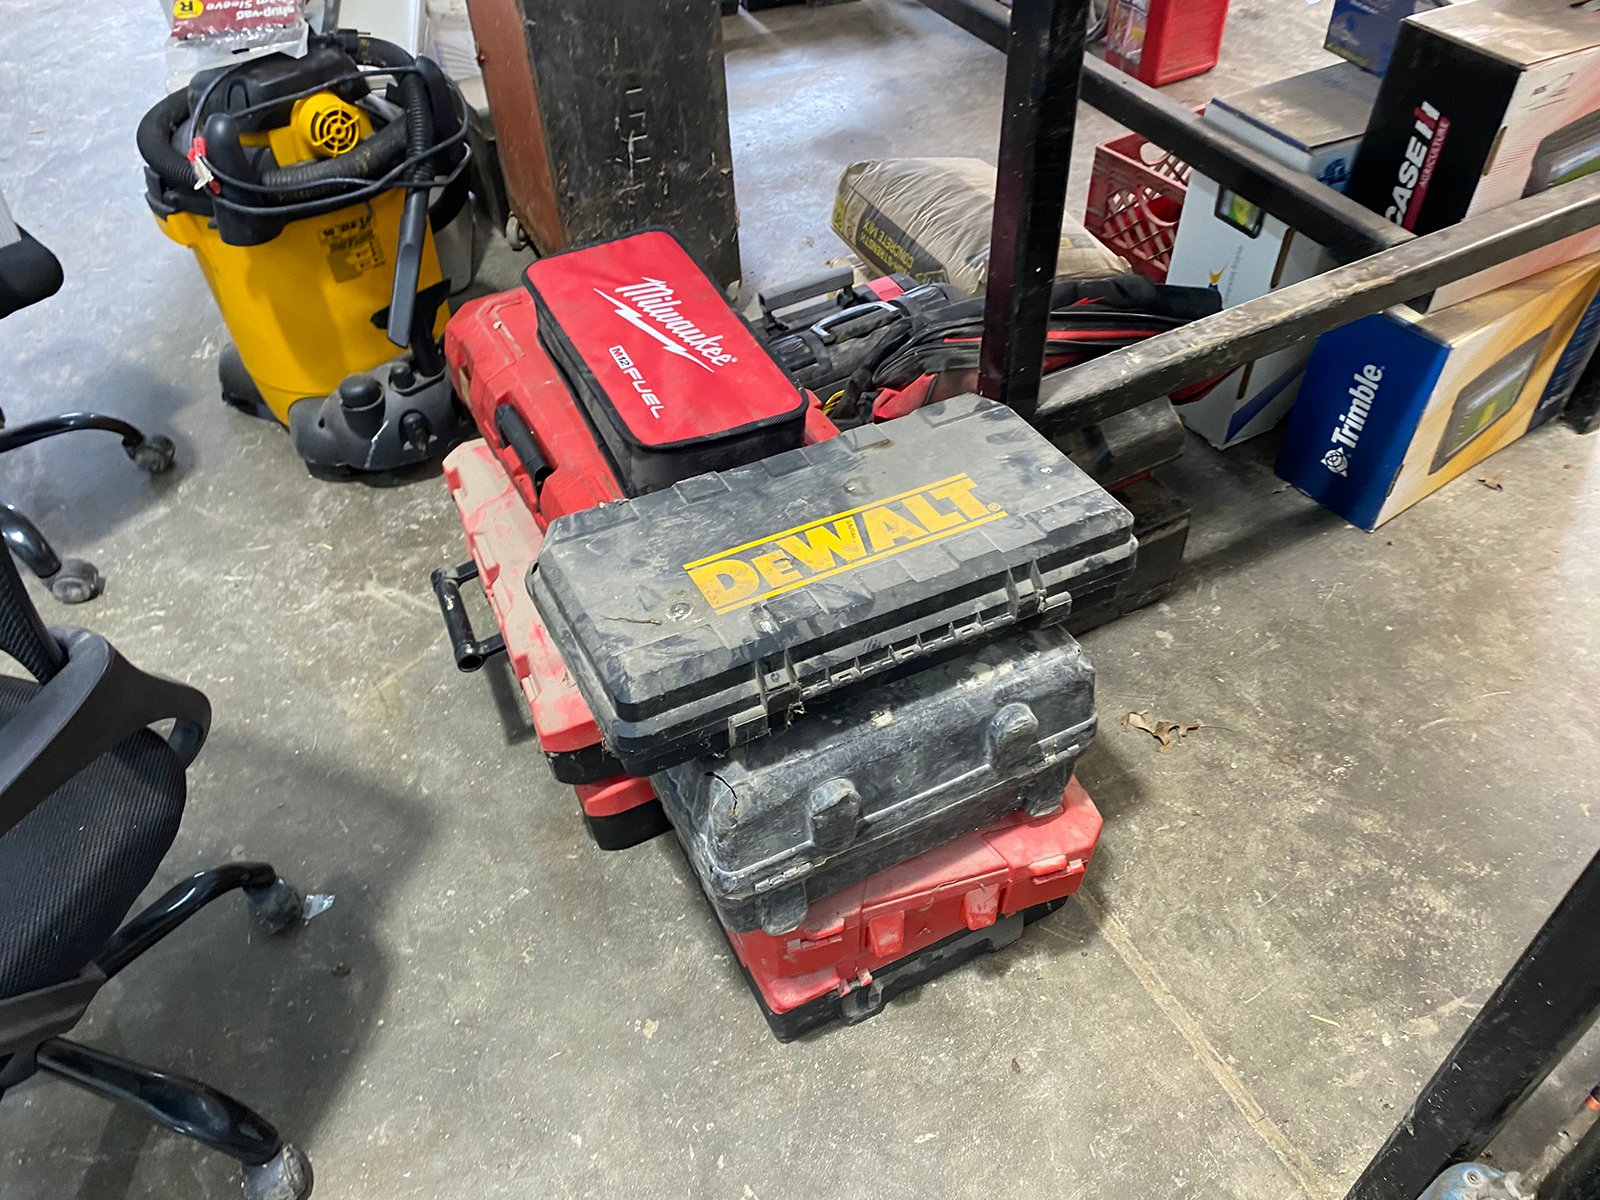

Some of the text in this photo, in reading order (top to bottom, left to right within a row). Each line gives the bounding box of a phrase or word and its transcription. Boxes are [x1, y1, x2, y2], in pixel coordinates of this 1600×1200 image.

[1385, 136, 1428, 225] CASE
[1419, 119, 1450, 189] AGRICULTURE
[862, 218, 878, 239] MIX
[879, 230, 914, 269] CONCRETE
[614, 276, 724, 366] Milwaukee
[611, 347, 665, 419] M12 FUEL
[1331, 364, 1383, 448] Trimble
